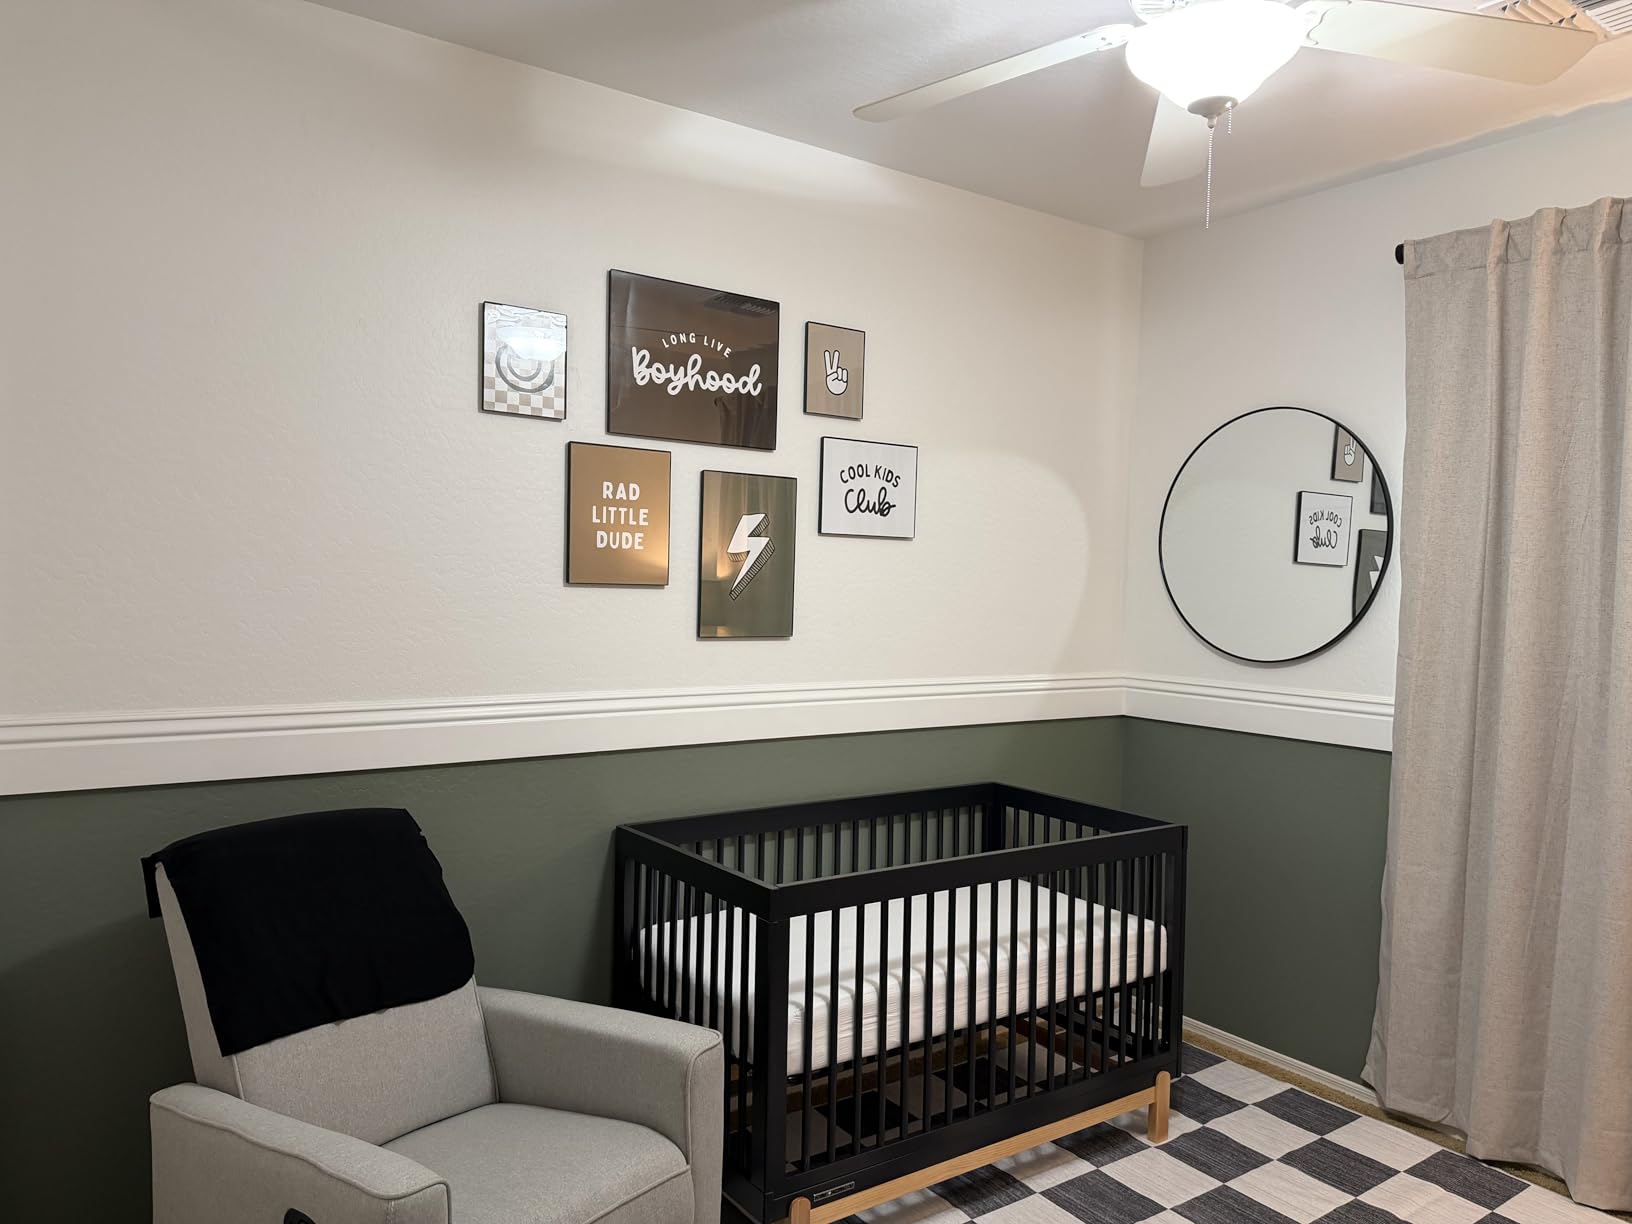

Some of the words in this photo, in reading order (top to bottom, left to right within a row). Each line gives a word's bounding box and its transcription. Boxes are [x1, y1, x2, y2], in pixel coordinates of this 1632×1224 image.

[662, 332, 696, 348] LONG
[703, 335, 732, 358] LIVE
[839, 463, 871, 484] COOL
[874, 464, 901, 488] KIDS
[602, 481, 640, 500] RAD
[844, 486, 897, 517] Club
[592, 505, 649, 526] LITTLE
[596, 530, 645, 550] DUDE
